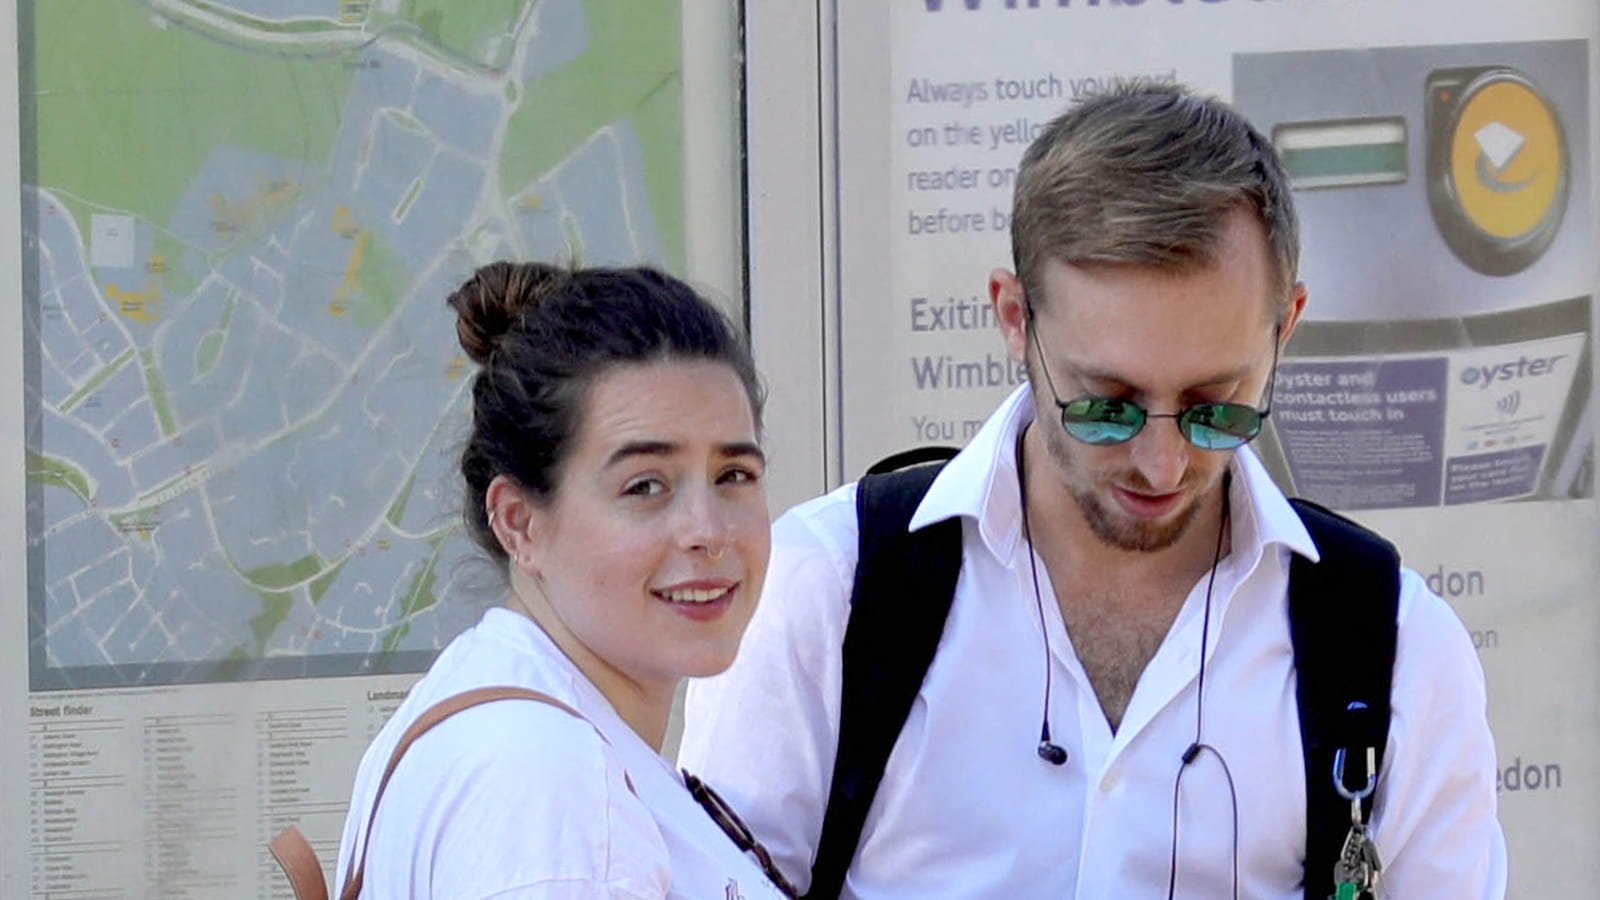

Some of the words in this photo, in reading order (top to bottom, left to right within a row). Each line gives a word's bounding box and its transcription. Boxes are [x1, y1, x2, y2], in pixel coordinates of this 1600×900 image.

[907, 78, 989, 107] Always
[995, 73, 1063, 101] touch
[907, 128, 937, 147] on
[944, 121, 982, 146] the
[907, 165, 980, 190] reader
[908, 207, 985, 234] before
[1337, 370, 1376, 387] and
[1461, 354, 1568, 389] oyster
[1273, 390, 1380, 406] contactless
[1386, 389, 1437, 403] users
[1280, 408, 1325, 422] must
[1328, 407, 1382, 422] touch
[1388, 407, 1405, 421] in
[911, 416, 954, 441] You
[30, 706, 61, 717] Street
[63, 704, 94, 716] finder
